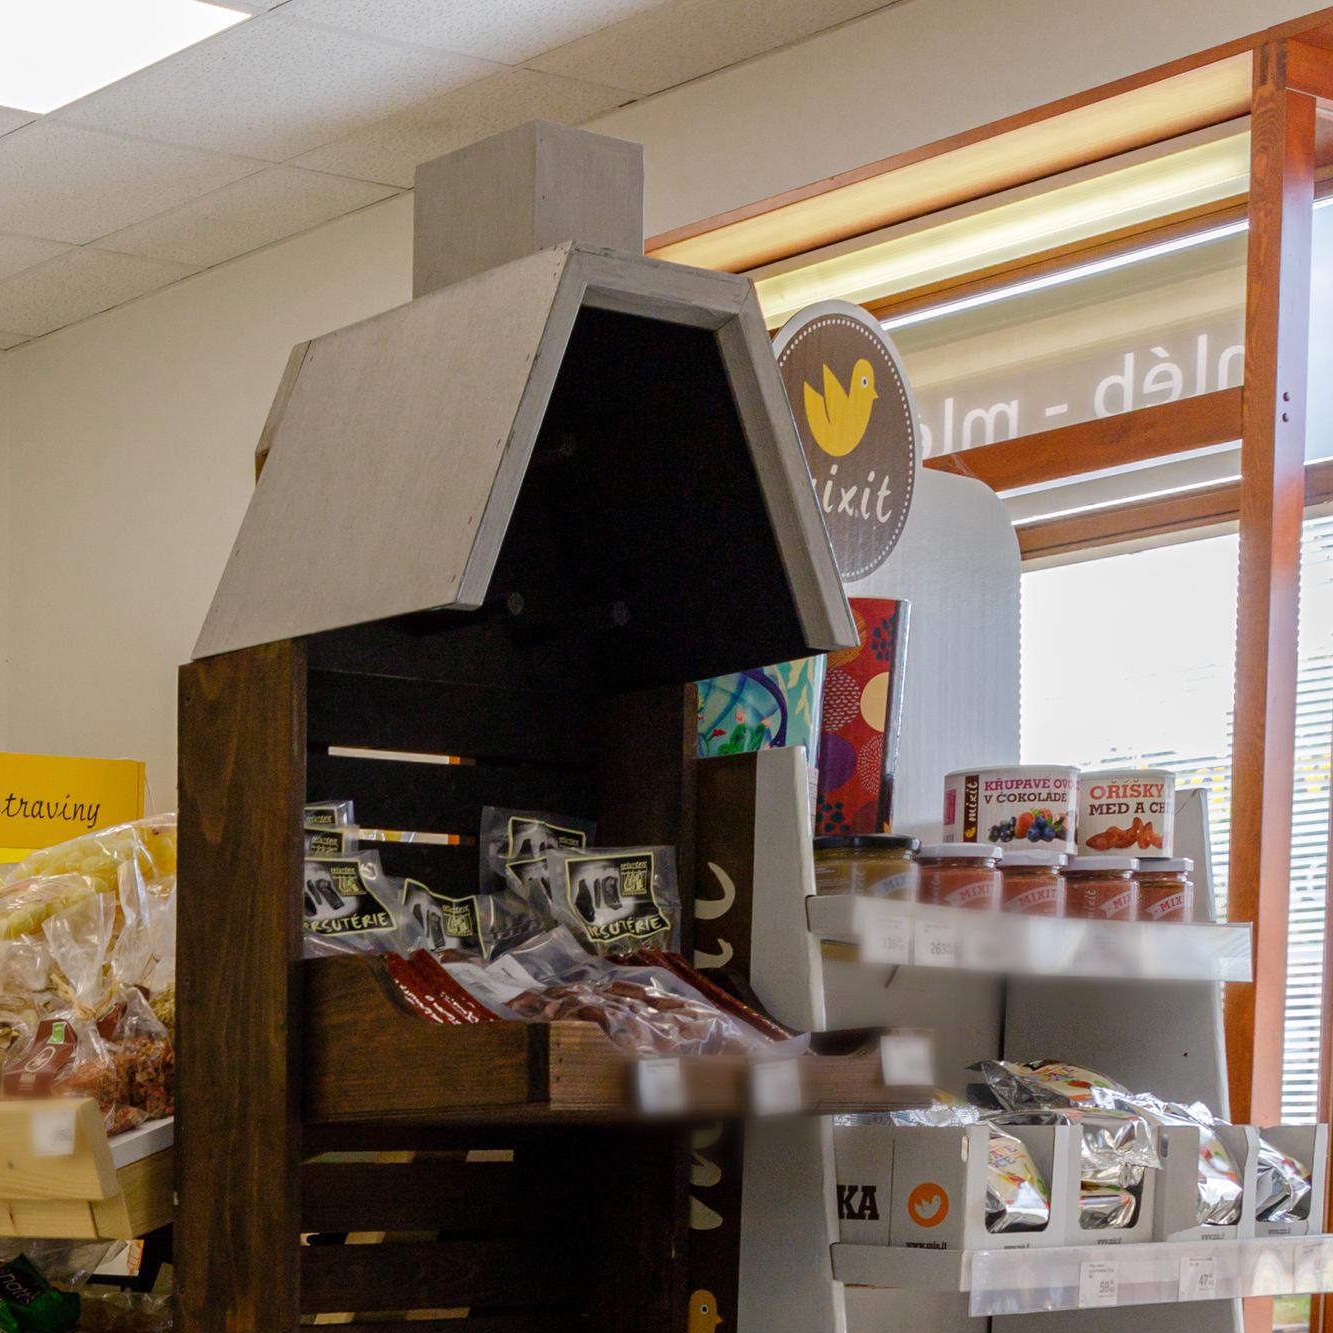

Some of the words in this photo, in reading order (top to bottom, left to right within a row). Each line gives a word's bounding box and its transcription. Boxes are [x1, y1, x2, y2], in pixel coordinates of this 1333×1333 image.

[811, 464, 894, 524] ixit
[985, 779, 1050, 792] KŘUPAVÉ
[1090, 779, 1164, 800] OŘÍŠKY
[984, 795, 991, 804] V
[1089, 803, 1129, 816] MED
[1134, 803, 1145, 814] A
